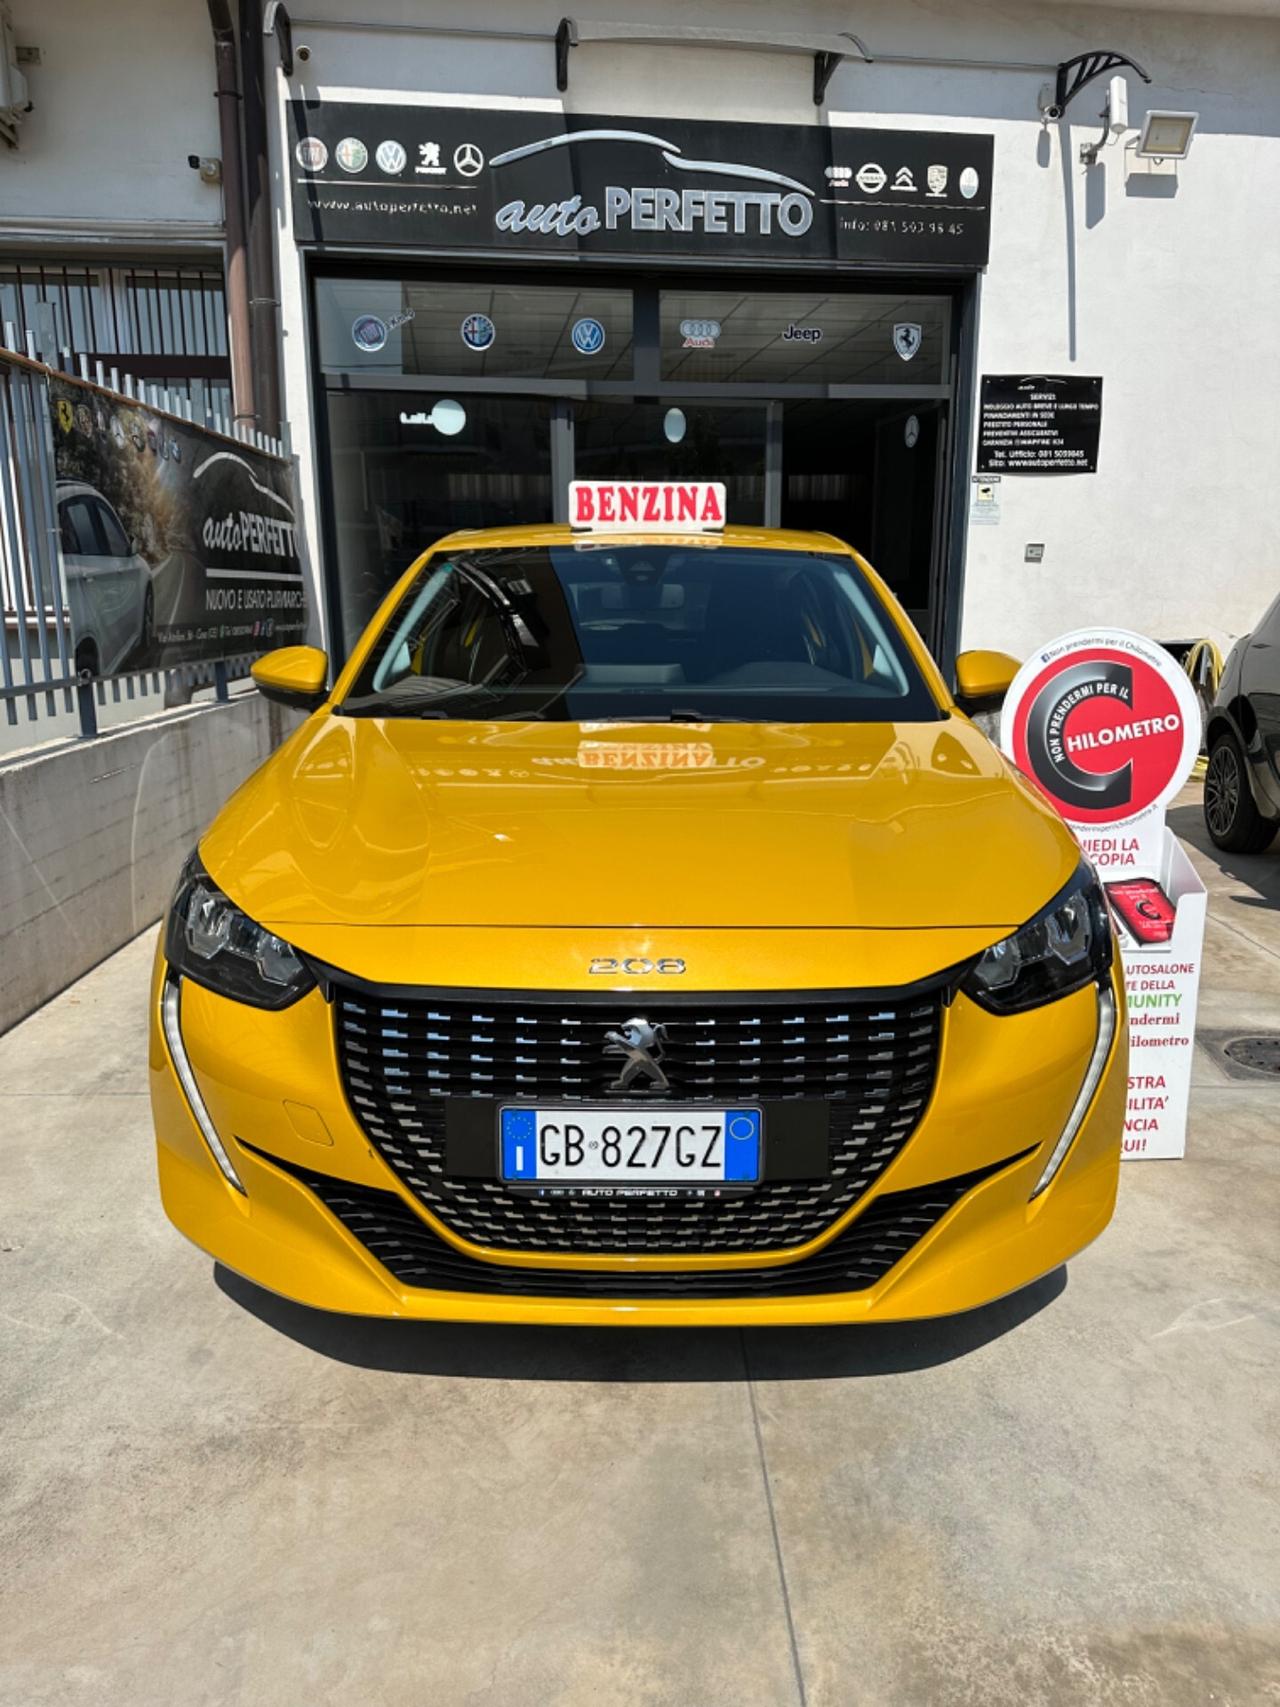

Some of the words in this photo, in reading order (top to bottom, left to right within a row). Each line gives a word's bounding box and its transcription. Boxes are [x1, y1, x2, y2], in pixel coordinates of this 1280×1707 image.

[605, 186, 813, 237] PERFETTO
[782, 323, 821, 345] Jeep
[575, 486, 722, 522] BENZINA
[206, 589, 237, 610] NUOVO
[238, 589, 243, 609] E
[1096, 682, 1118, 694] PER
[1119, 686, 1129, 699] IL
[1049, 684, 1094, 736] PRENDERMI
[1066, 713, 1180, 753] HILOMETRO
[1049, 738, 1066, 763] NON
[1122, 838, 1139, 851] LA
[588, 958, 686, 975] 208
[1140, 979, 1175, 991] DELLA
[540, 1124, 585, 1167] GB
[601, 1126, 722, 1168] 827GZ
[582, 1188, 613, 1197] AUTO
[616, 1189, 678, 1197] PERFETTO
